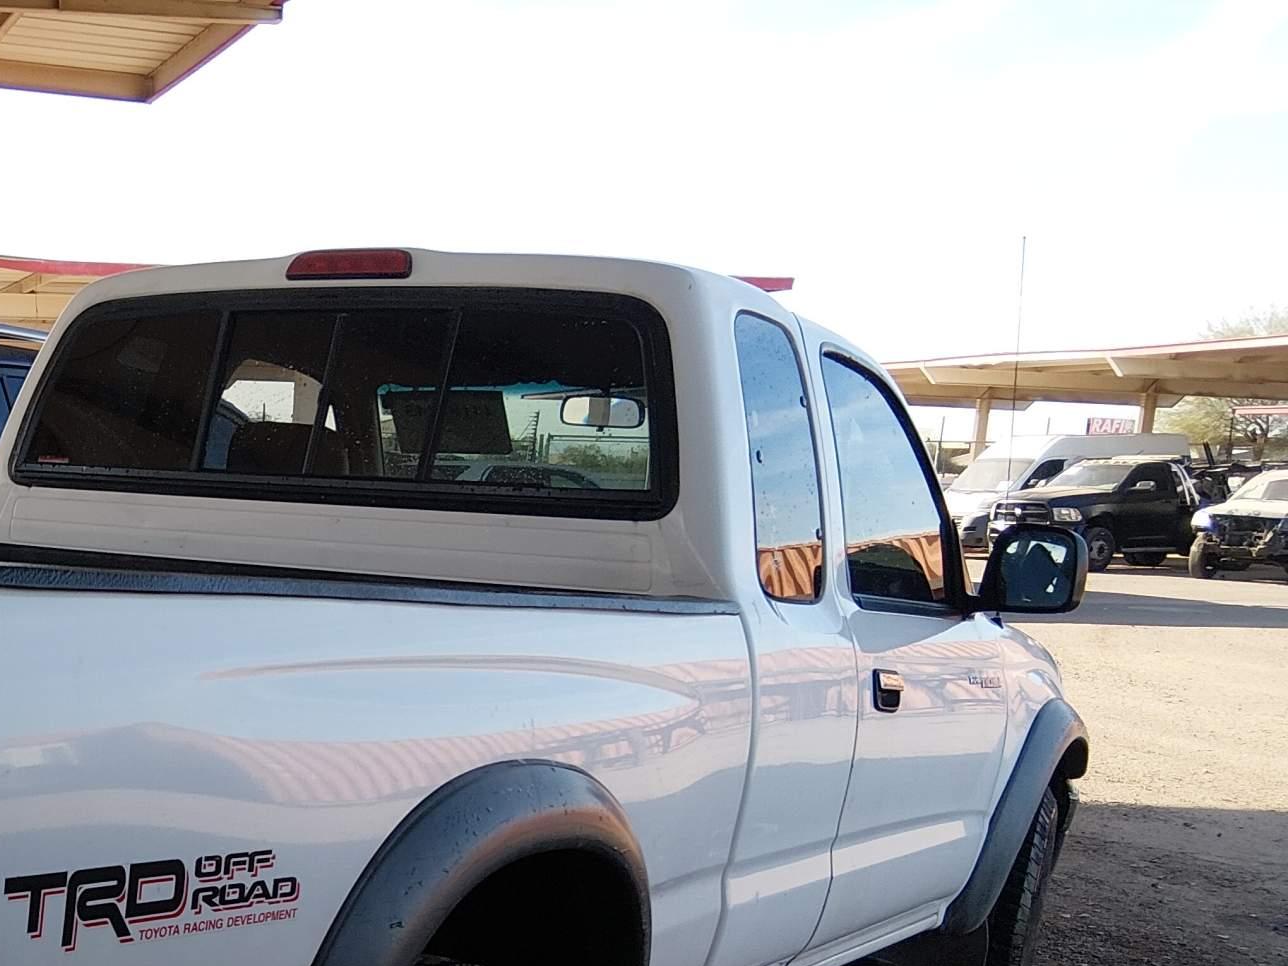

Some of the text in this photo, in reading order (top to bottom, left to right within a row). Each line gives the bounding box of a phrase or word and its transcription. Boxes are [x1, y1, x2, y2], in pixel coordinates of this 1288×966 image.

[195, 849, 276, 882] OFF
[4, 859, 189, 952] TRD
[191, 876, 301, 915] ROAD
[139, 907, 300, 941] TOYOTA RACING DEVELOPMENT
